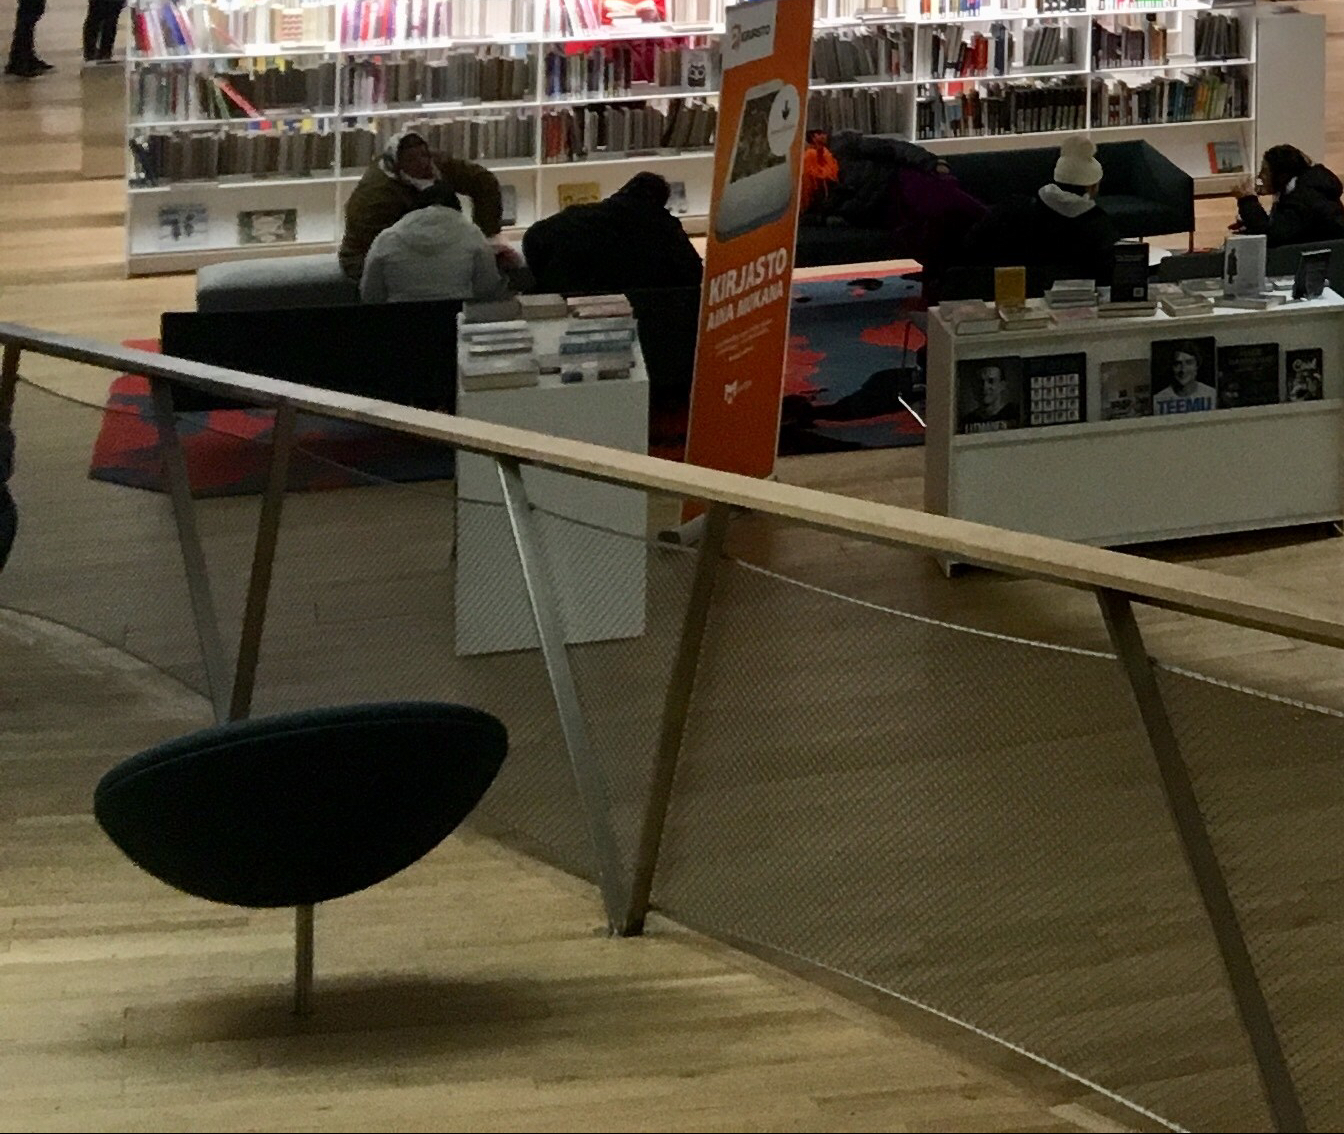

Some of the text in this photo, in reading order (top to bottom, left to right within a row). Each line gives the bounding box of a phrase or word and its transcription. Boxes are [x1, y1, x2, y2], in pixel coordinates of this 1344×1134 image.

[708, 247, 787, 306] KIRJASTO
[706, 280, 784, 332] AINA MUKANA
[1156, 396, 1212, 415] TEEMU
